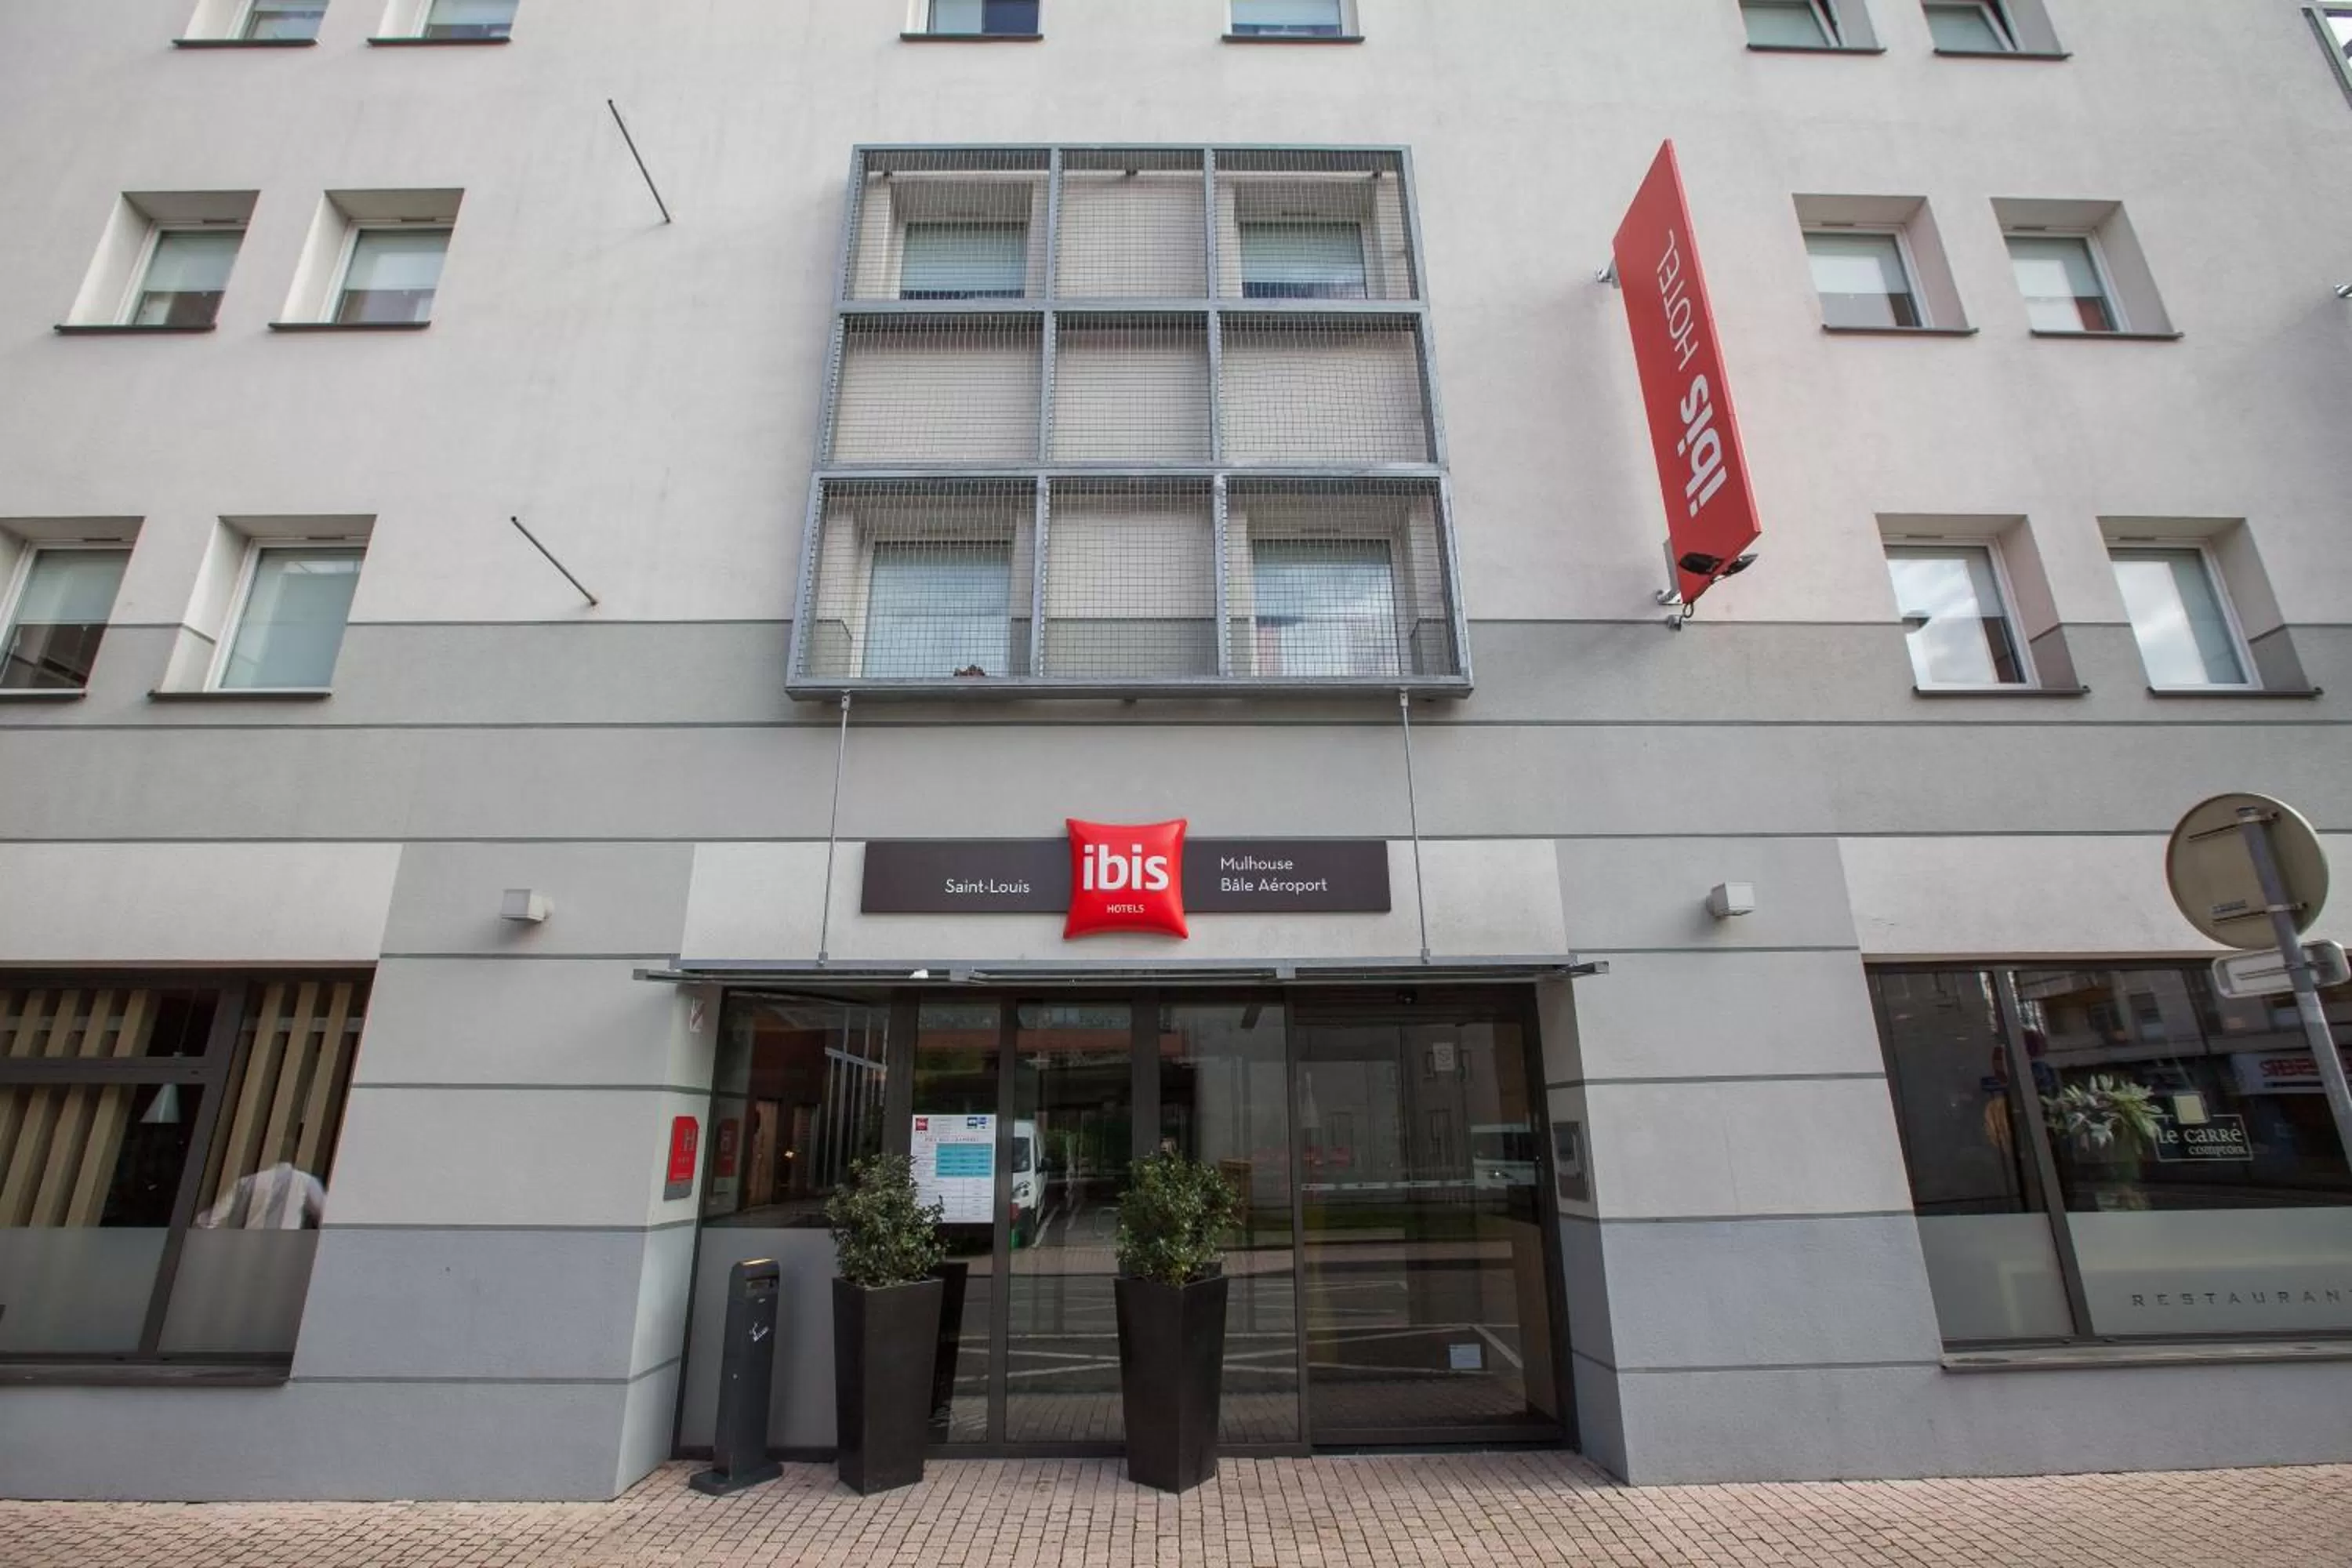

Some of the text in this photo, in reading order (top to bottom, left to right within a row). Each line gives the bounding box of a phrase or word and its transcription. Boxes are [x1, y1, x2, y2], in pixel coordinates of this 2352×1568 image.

[1657, 229, 1726, 517] ibis HOTEL
[1083, 844, 1169, 891] ibis
[1221, 855, 1294, 870] Mulhouse
[945, 879, 1030, 893] Saint-Louis
[1221, 877, 1328, 895] Bâle Aéroport
[1106, 904, 1145, 913] HOTELS
[2132, 1290, 2352, 1306] RESTAURAN
